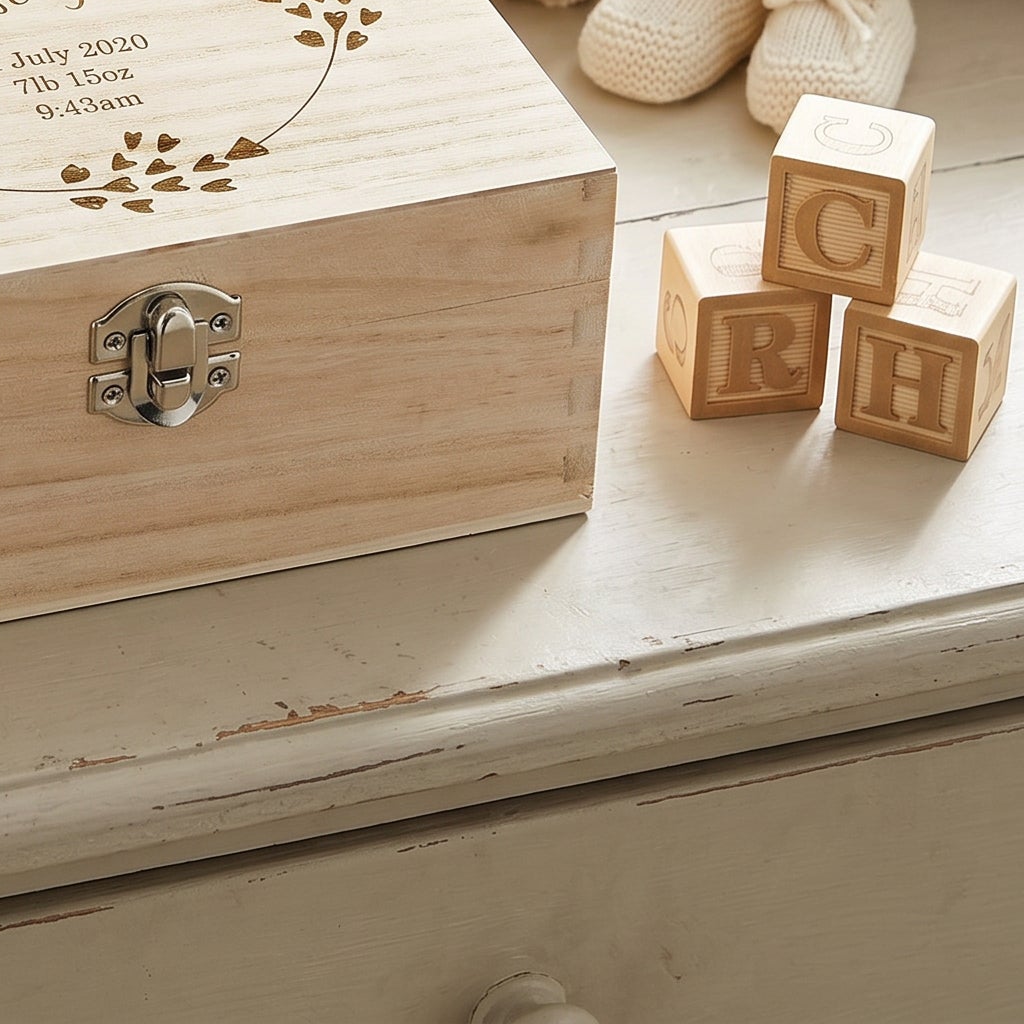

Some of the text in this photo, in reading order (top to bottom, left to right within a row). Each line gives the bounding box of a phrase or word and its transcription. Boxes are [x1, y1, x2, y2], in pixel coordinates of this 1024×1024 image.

[11, 48, 69, 69] July
[78, 34, 149, 58] 2020
[13, 68, 134, 94] 7lb 15oz
[35, 93, 144, 120] 9:43am
[794, 188, 876, 272] C
[716, 312, 804, 395] R
[862, 335, 954, 434] H
